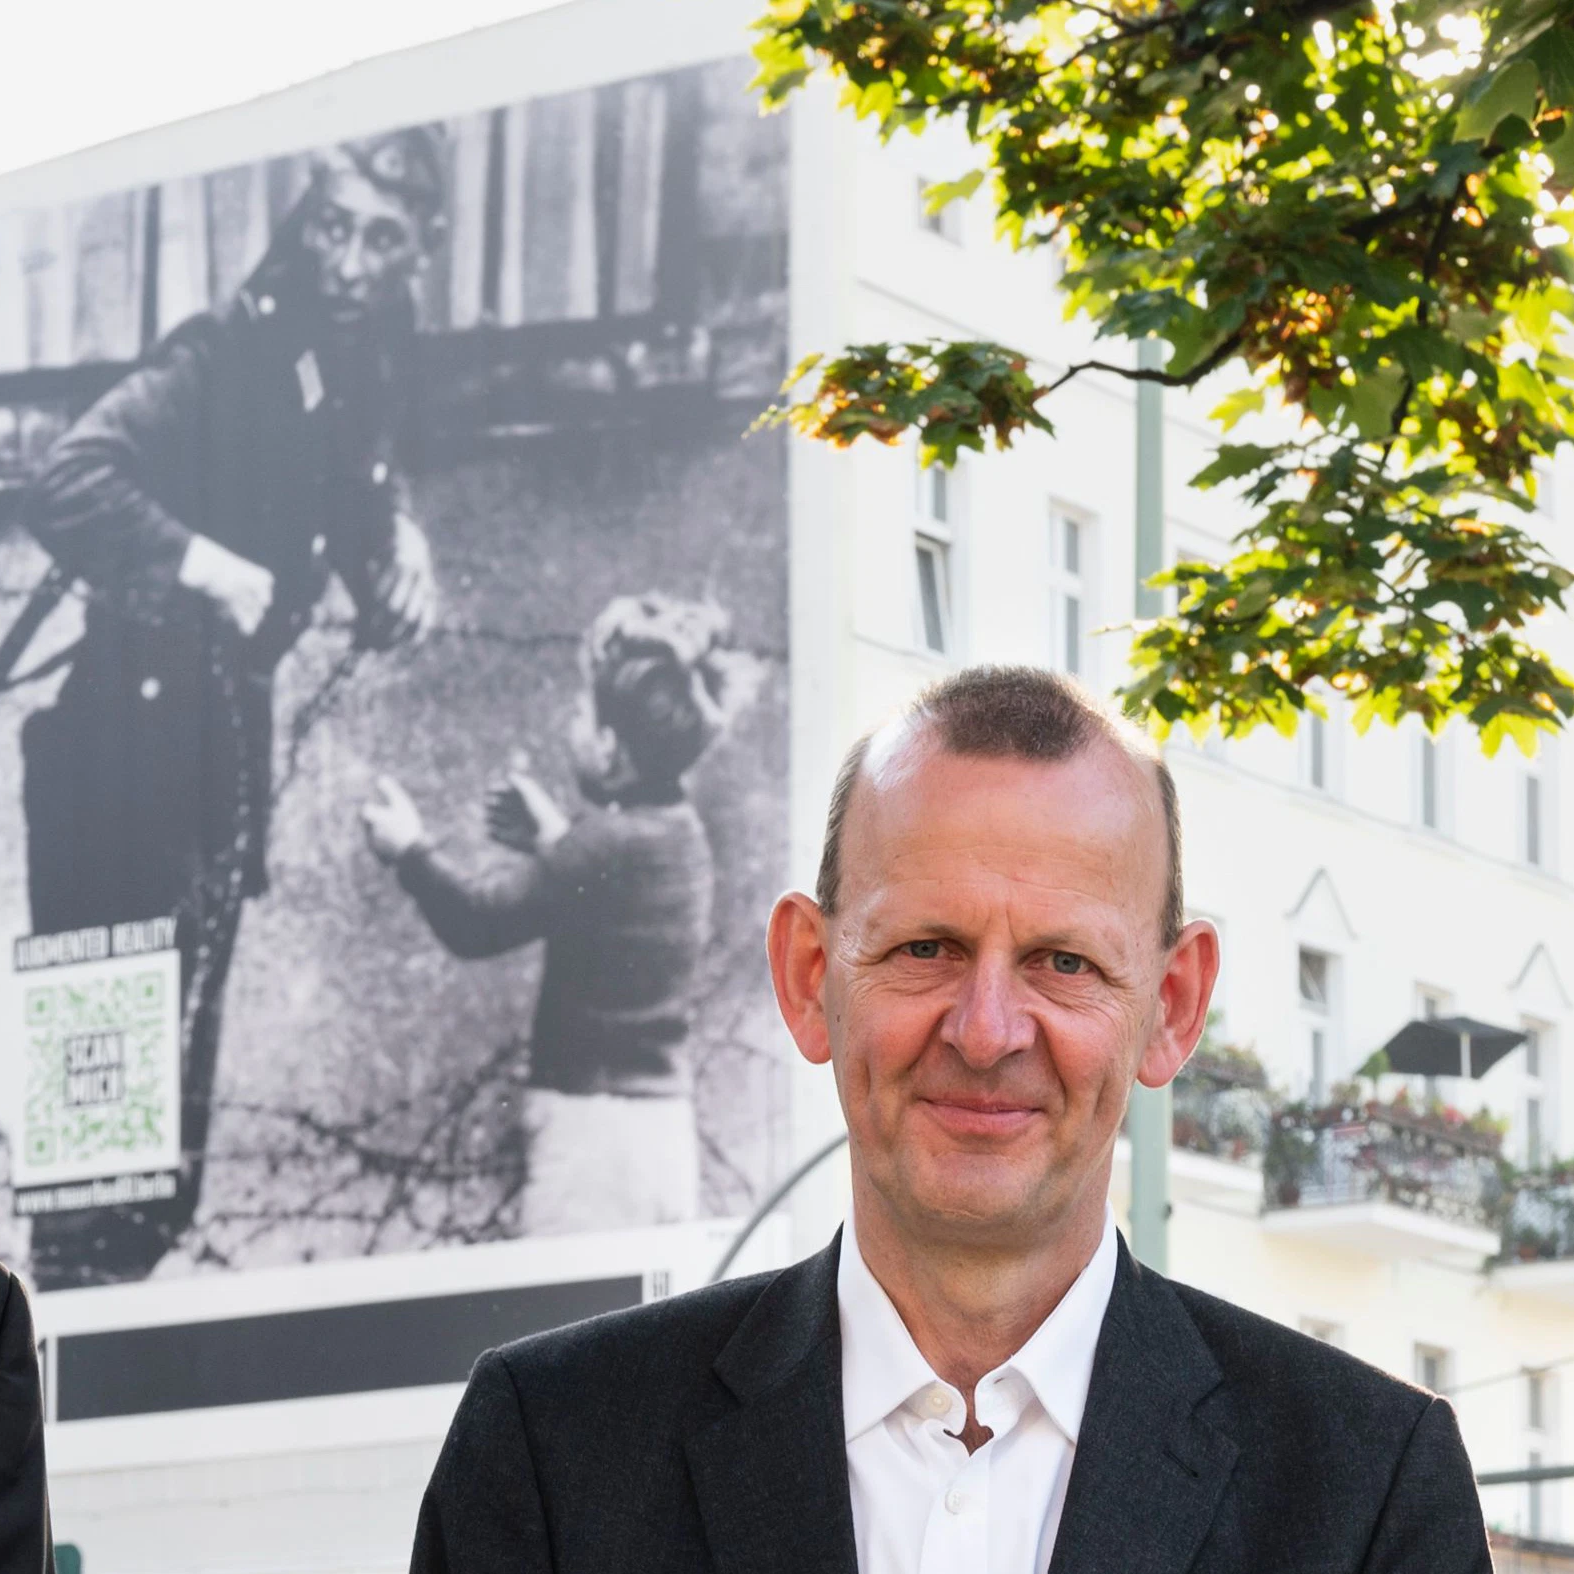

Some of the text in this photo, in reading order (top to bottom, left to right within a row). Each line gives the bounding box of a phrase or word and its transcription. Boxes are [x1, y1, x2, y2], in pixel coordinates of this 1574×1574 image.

[17, 917, 176, 969] AUGMENTED REALITY
[67, 1034, 122, 1071] SCAN
[67, 1066, 122, 1104] MICH
